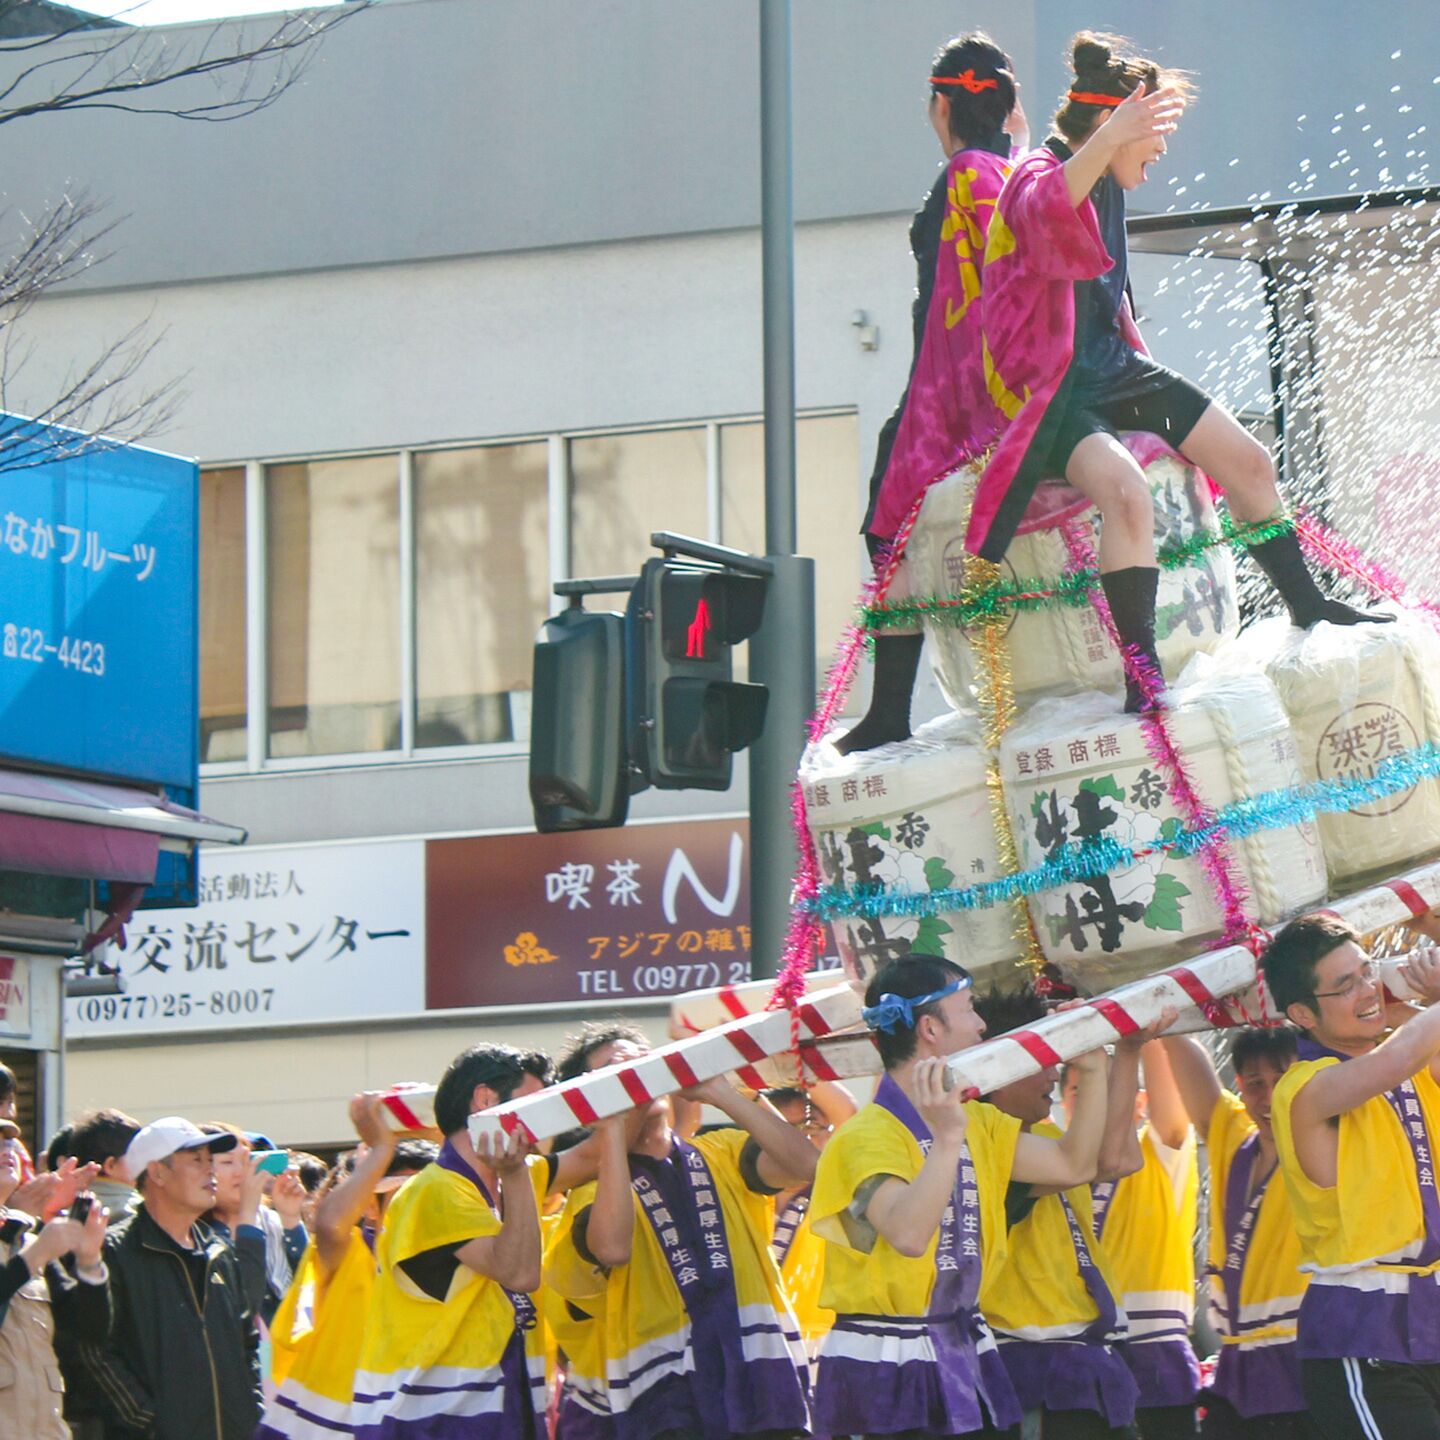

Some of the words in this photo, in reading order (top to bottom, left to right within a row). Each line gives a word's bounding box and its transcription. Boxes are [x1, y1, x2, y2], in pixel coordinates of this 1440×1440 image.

[0, 511, 156, 581] なかフルーツ
[199, 869, 304, 904] 活動法人
[546, 859, 642, 910] 喫茶
[578, 969, 625, 994] TEL
[632, 962, 722, 992] (0977)
[76, 989, 276, 1022] (0977)25-8007
